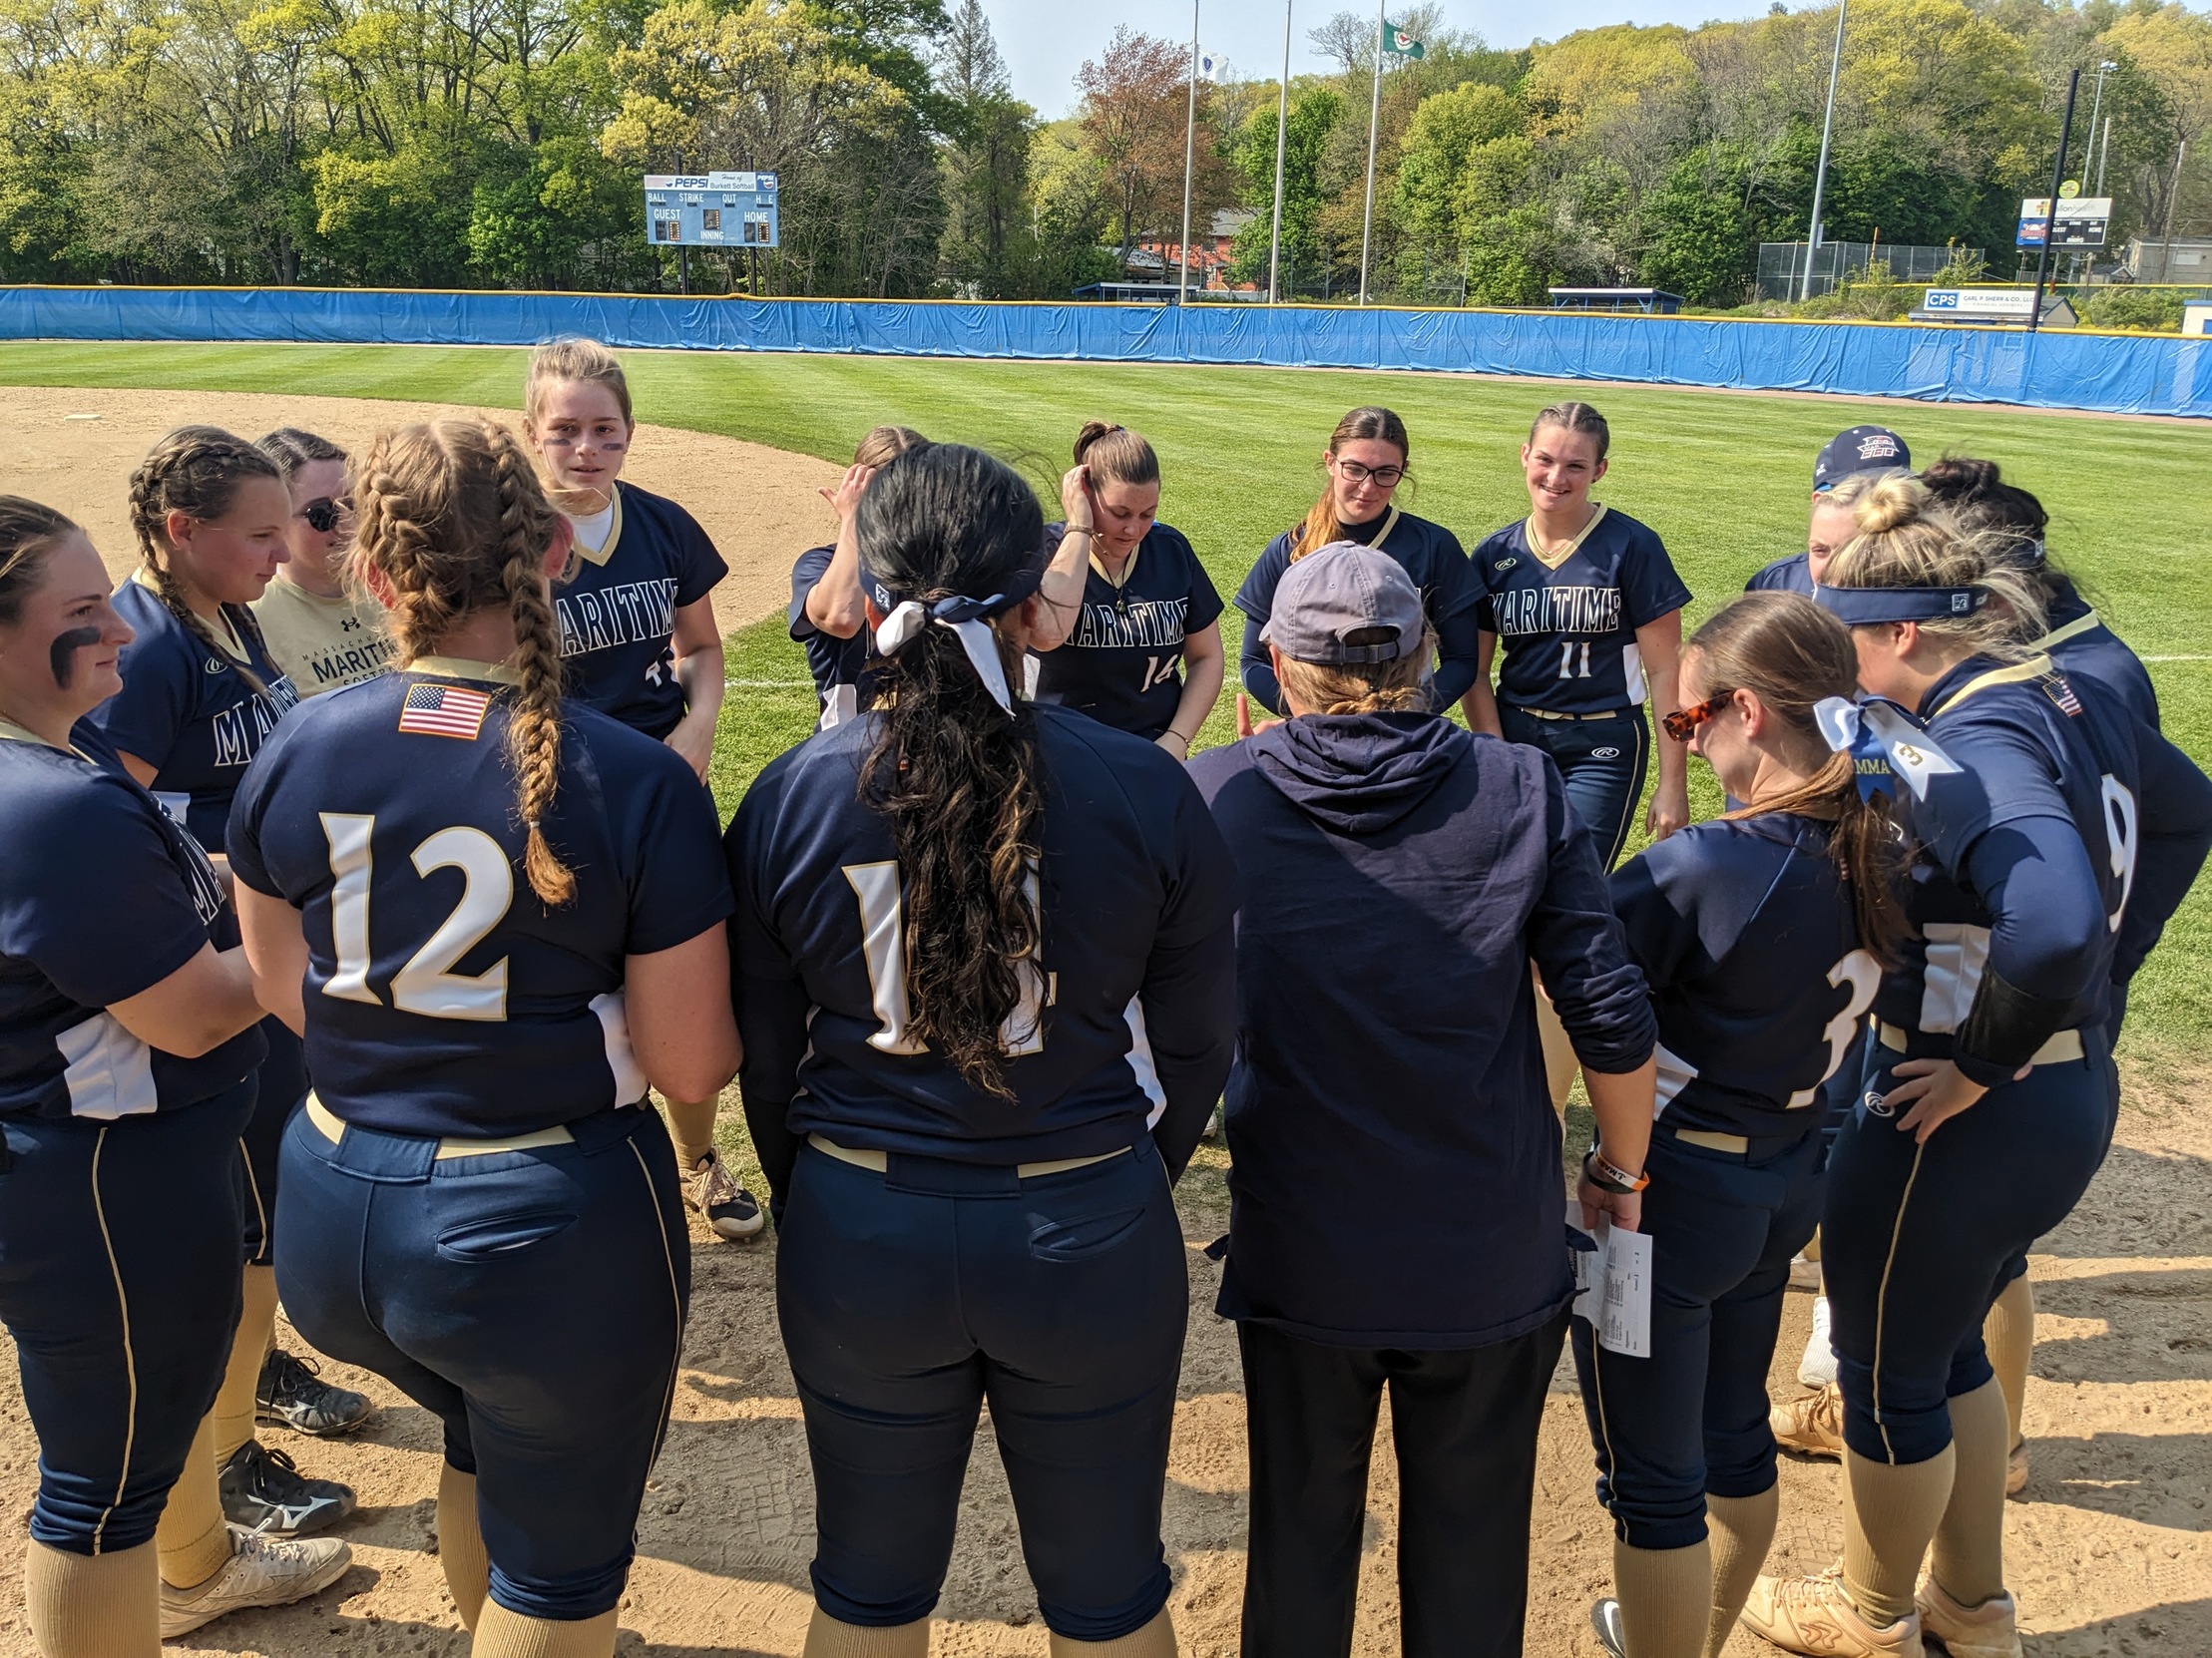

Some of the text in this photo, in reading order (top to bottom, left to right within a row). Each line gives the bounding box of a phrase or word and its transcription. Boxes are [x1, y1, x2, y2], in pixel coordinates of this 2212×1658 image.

[674, 178, 708, 188] PEPSI
[649, 193, 666, 203] BALL
[678, 193, 704, 203] STRIKE
[722, 194, 736, 203] OUT
[654, 208, 768, 222] GUEST HOME
[700, 230, 724, 240] INNING
[1929, 294, 1956, 306] CPS
[1558, 641, 1592, 679] 11
[1899, 744, 1924, 766] 3
[1854, 758, 1891, 775] MMA
[318, 811, 514, 1022] 12
